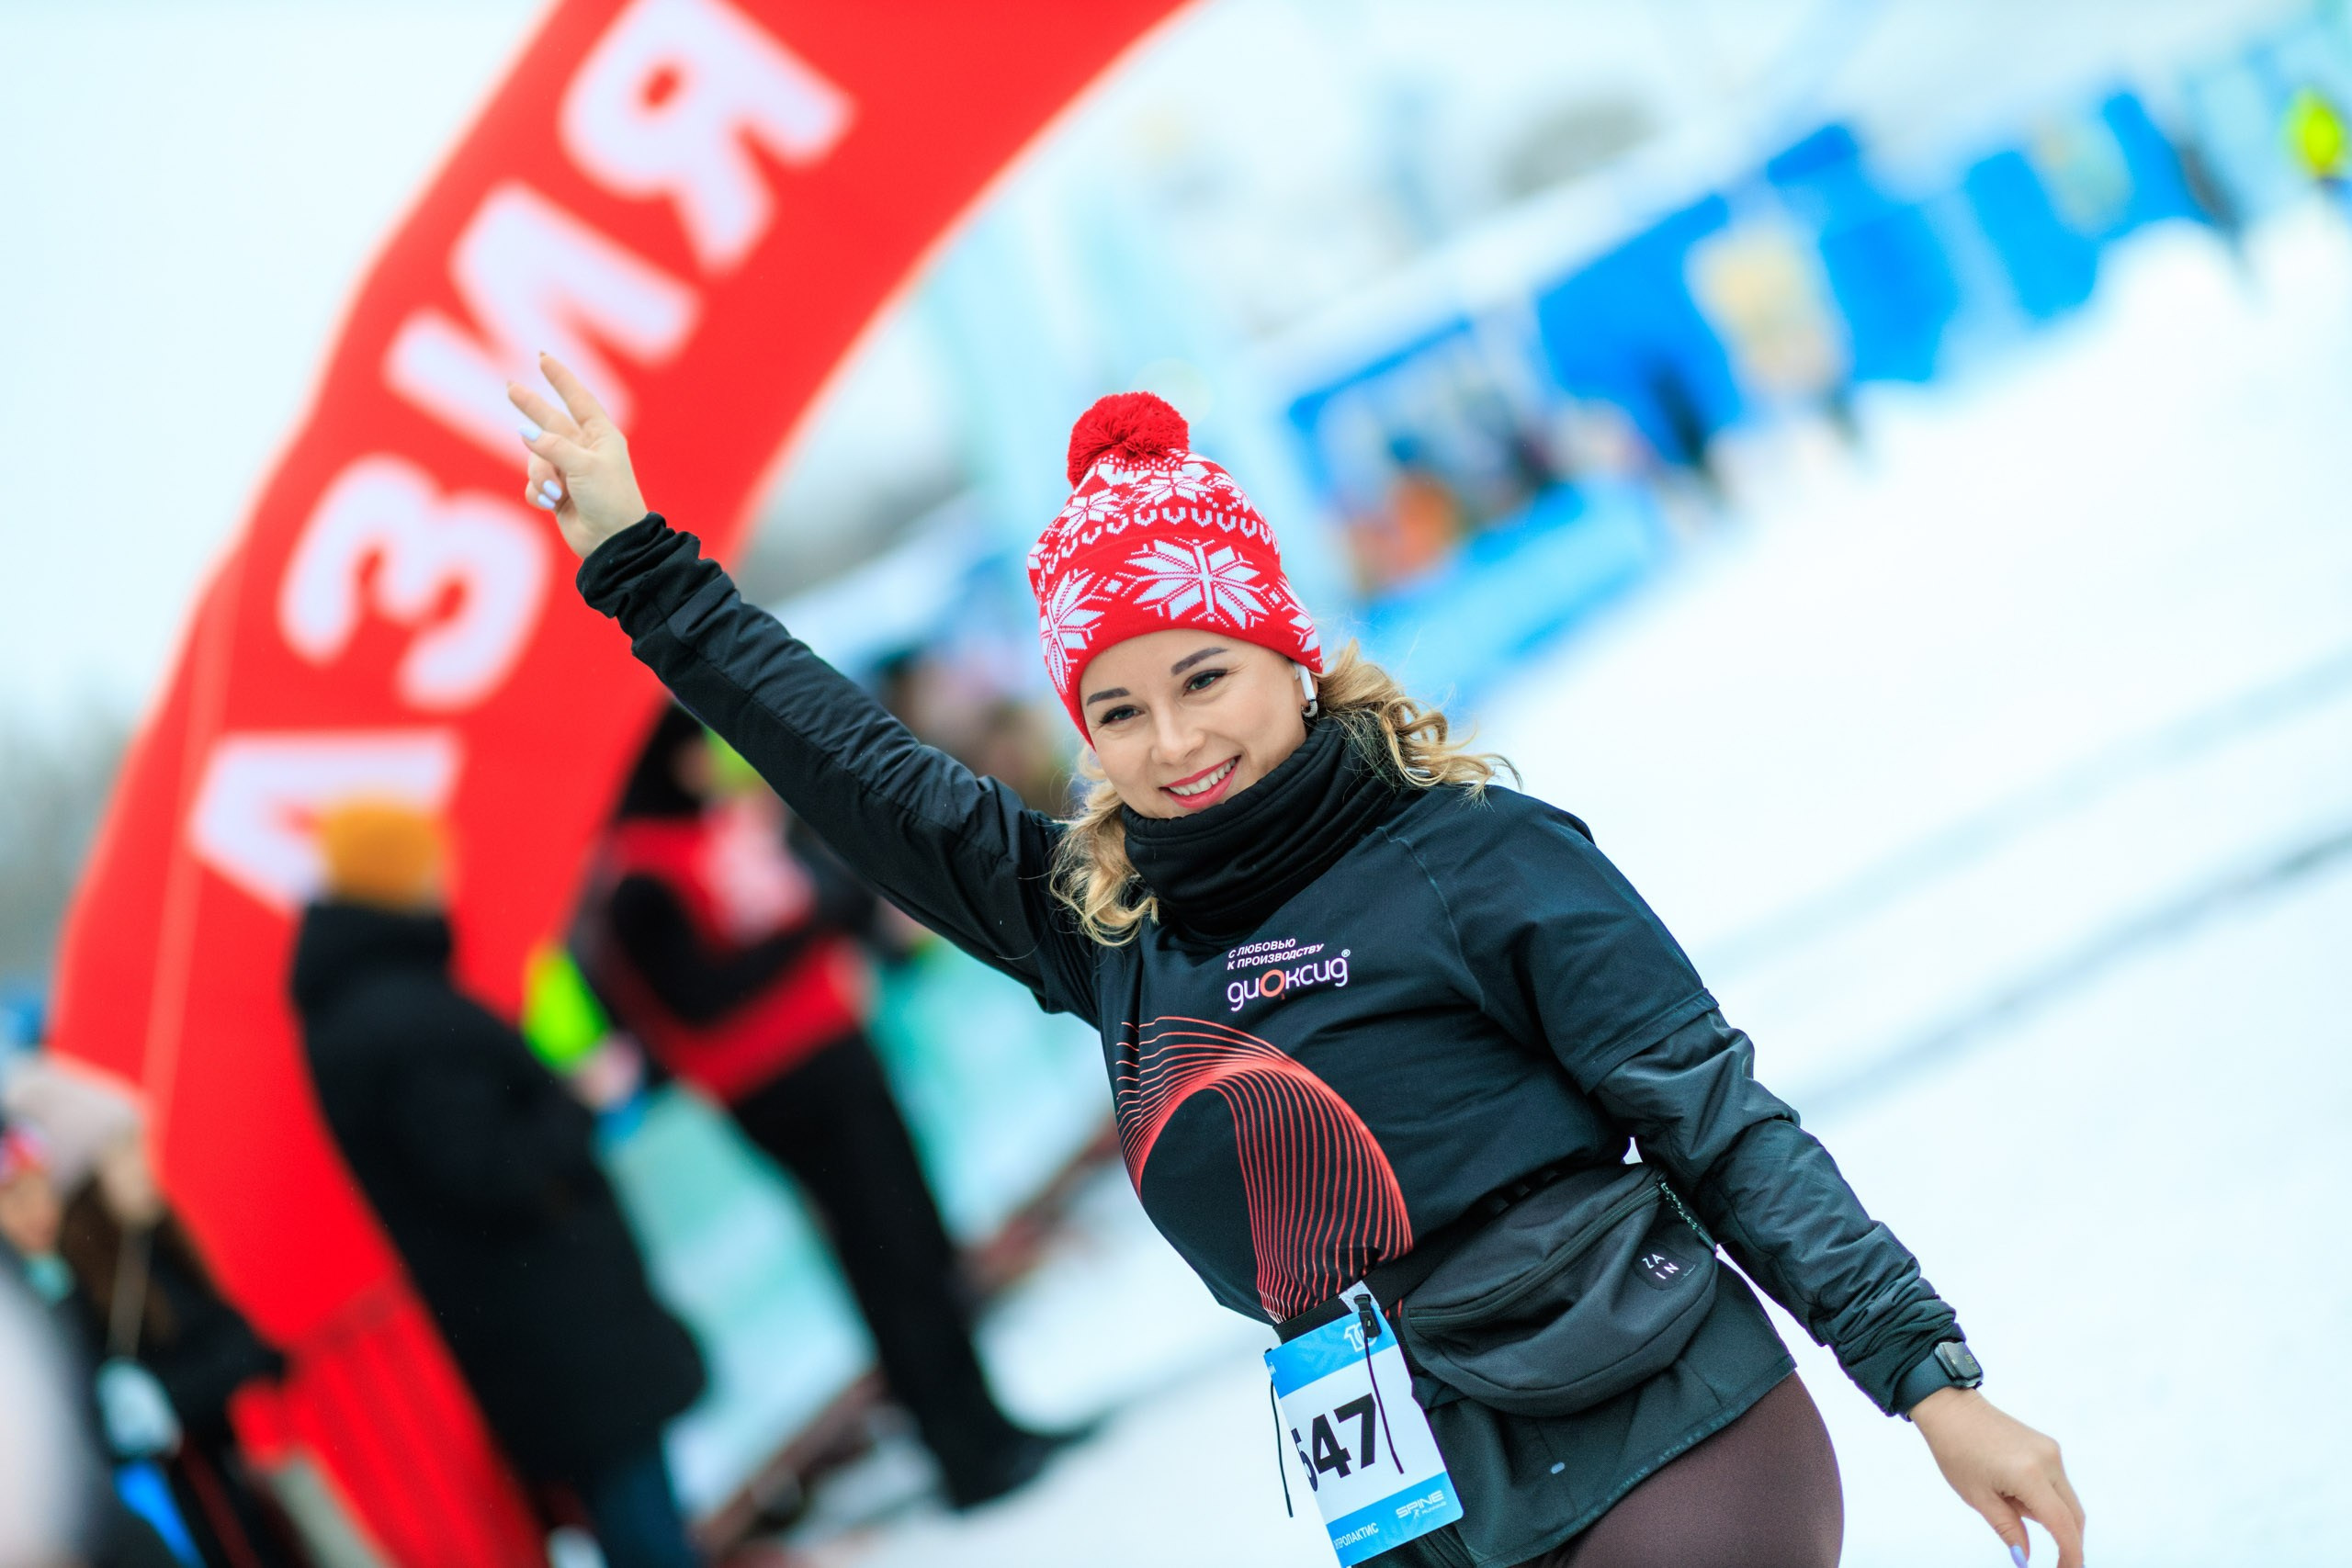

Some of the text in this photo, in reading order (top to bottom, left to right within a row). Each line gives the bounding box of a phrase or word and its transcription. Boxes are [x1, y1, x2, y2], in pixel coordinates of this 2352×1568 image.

[1227, 943, 1325, 971] К ПРОИЗВОДСТВУ
[1228, 938, 1296, 959] С ЛЮБОВЬЮ
[1396, 1489, 1444, 1519] SPINE
